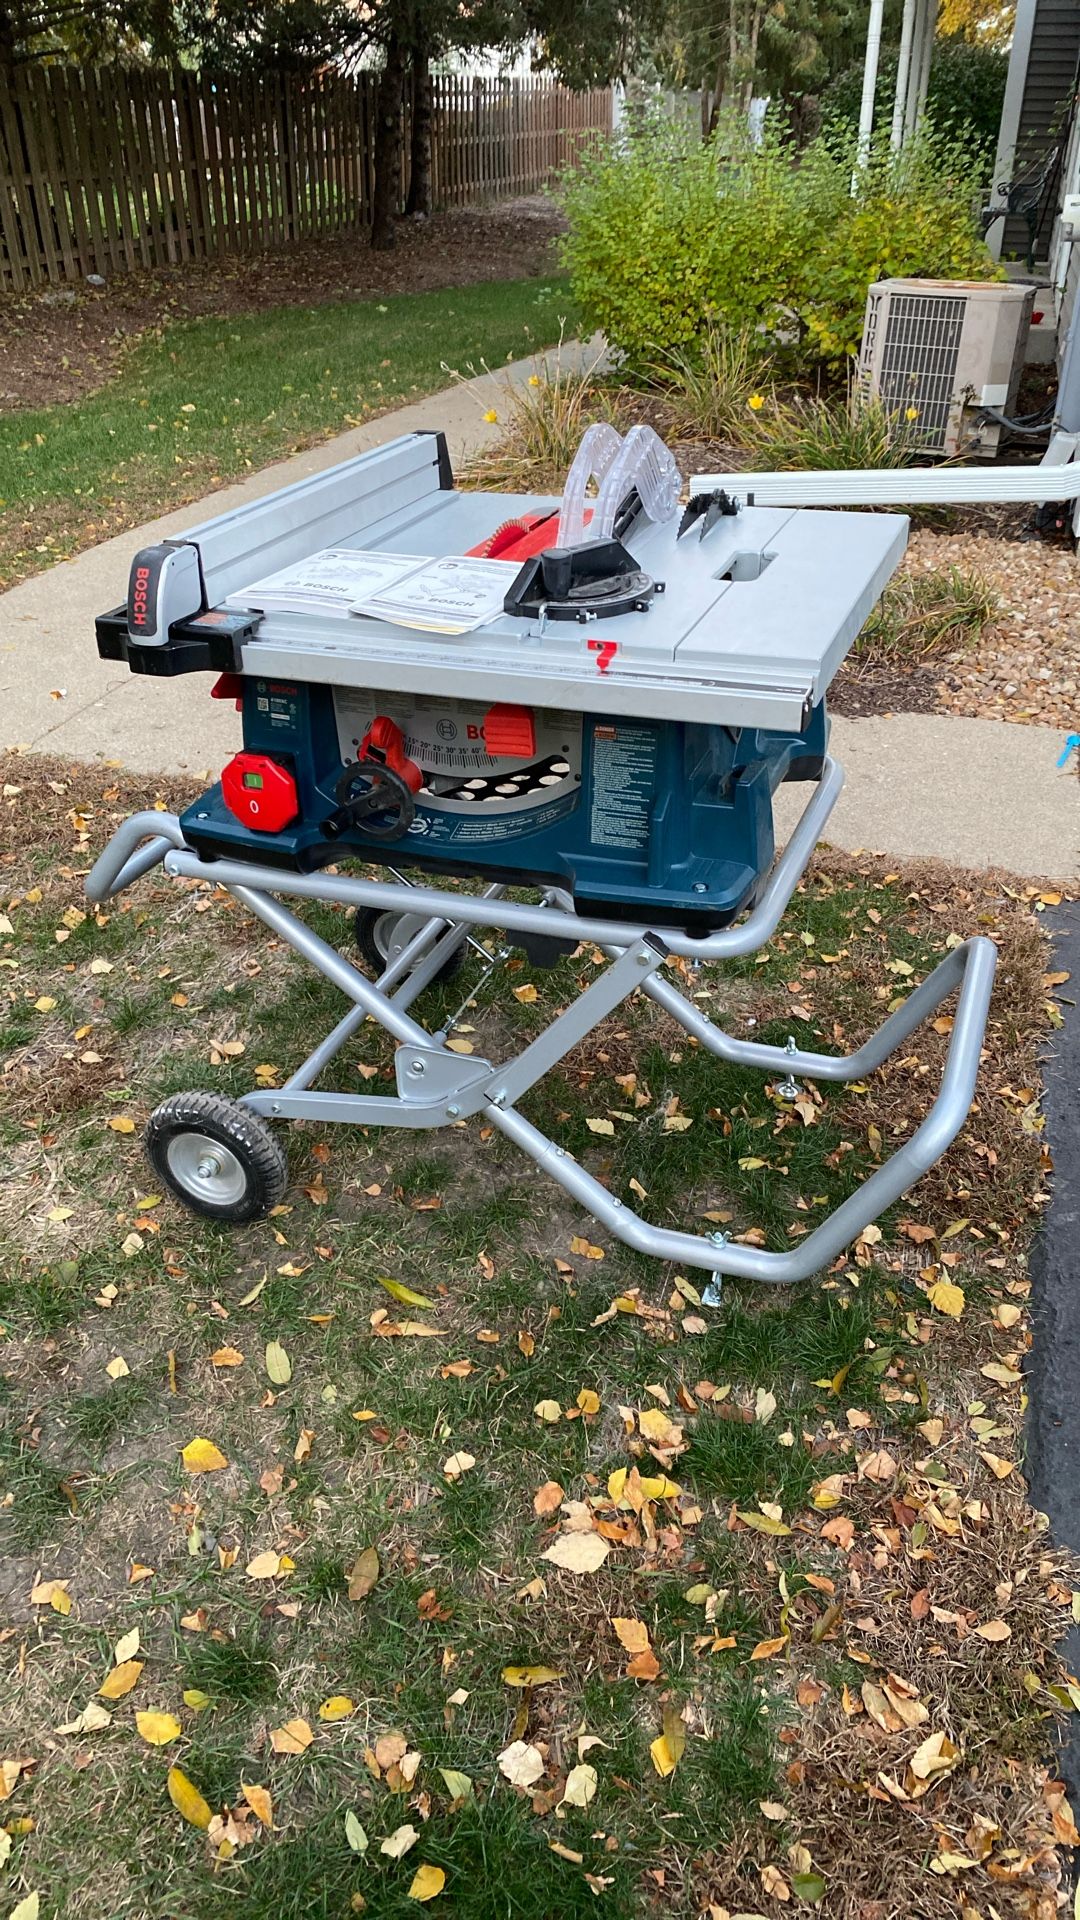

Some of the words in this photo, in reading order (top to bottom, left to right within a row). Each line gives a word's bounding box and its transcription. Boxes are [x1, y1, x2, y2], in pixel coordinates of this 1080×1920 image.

[864, 296, 882, 364] YORK
[133, 567, 150, 625] BOSCH
[303, 582, 349, 592] BOSCH
[427, 597, 475, 607] BOSCH
